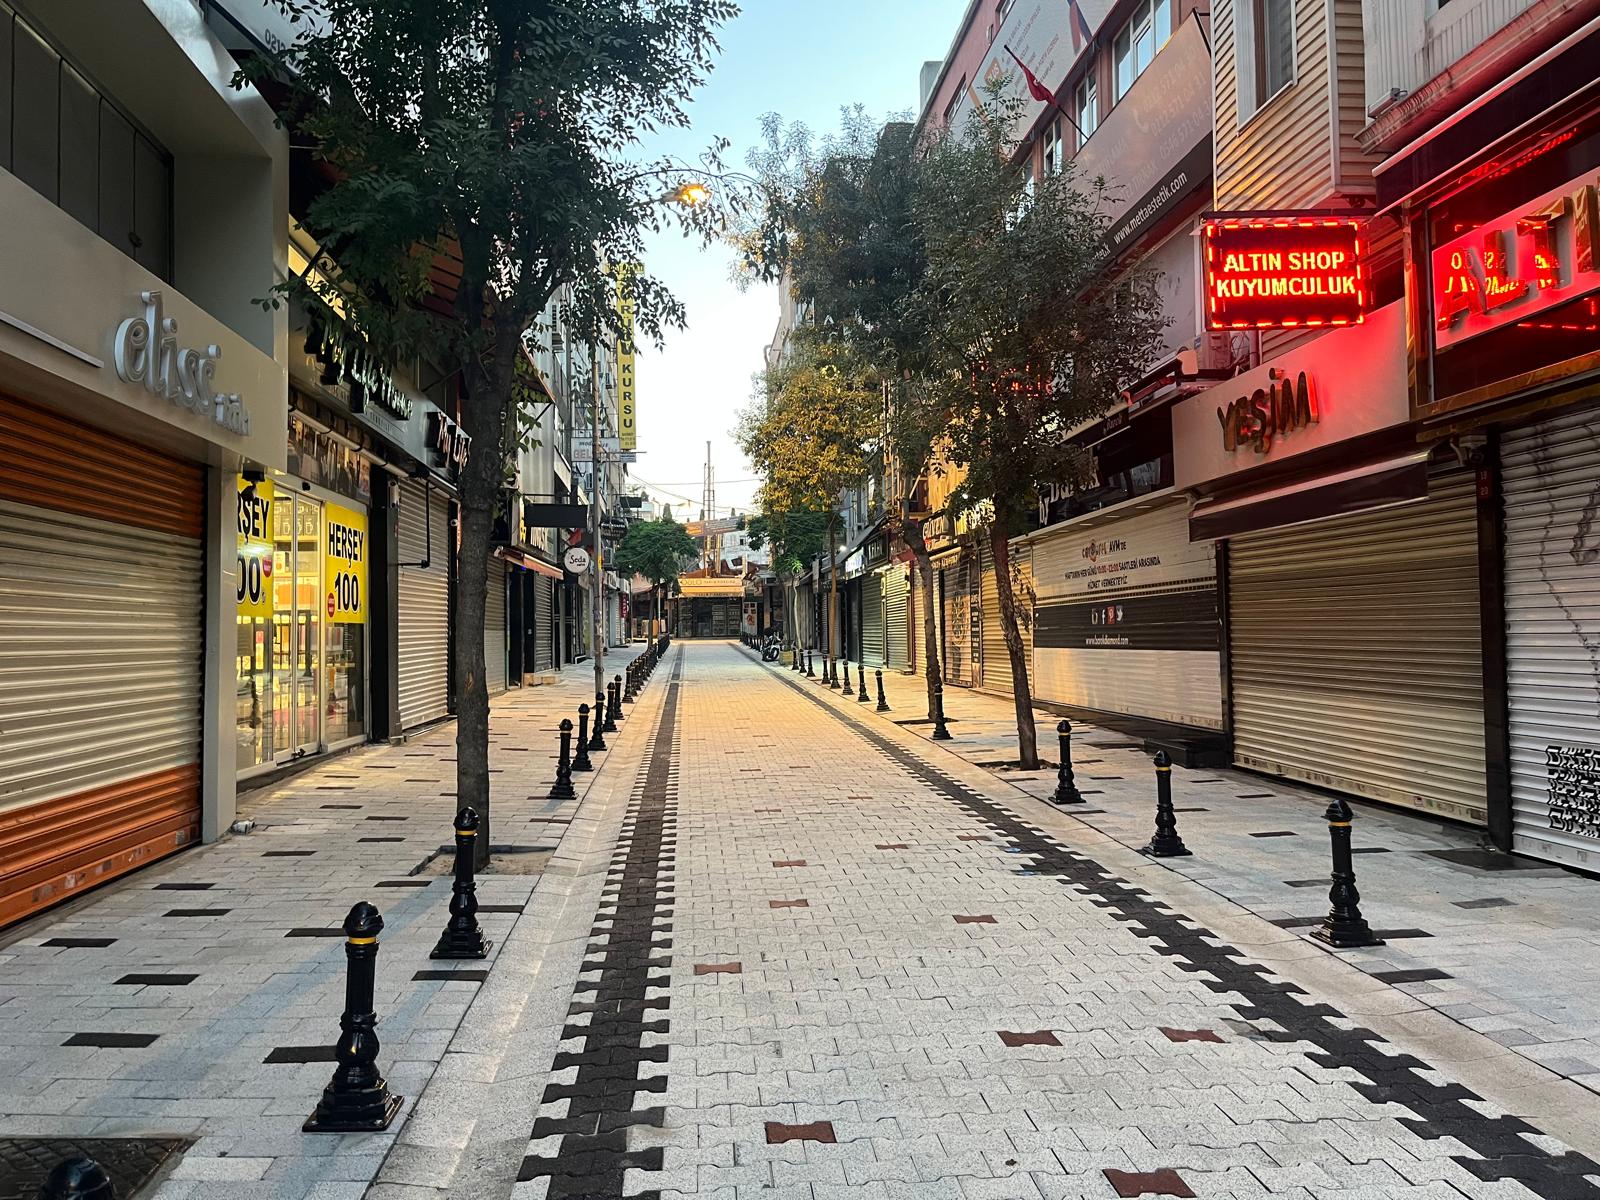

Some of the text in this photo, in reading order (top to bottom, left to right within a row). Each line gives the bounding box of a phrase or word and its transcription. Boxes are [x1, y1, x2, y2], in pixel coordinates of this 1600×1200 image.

[1113, 171, 1189, 246] www.mettaestetik.com
[1223, 251, 1345, 273] ALTIN SHOP
[1217, 276, 1356, 298] KUYUMCULUK
[621, 363, 633, 429] KURSU
[1216, 366, 1320, 455] YEŞİM
[328, 521, 364, 569] HERŞEY
[334, 571, 360, 613] 100
